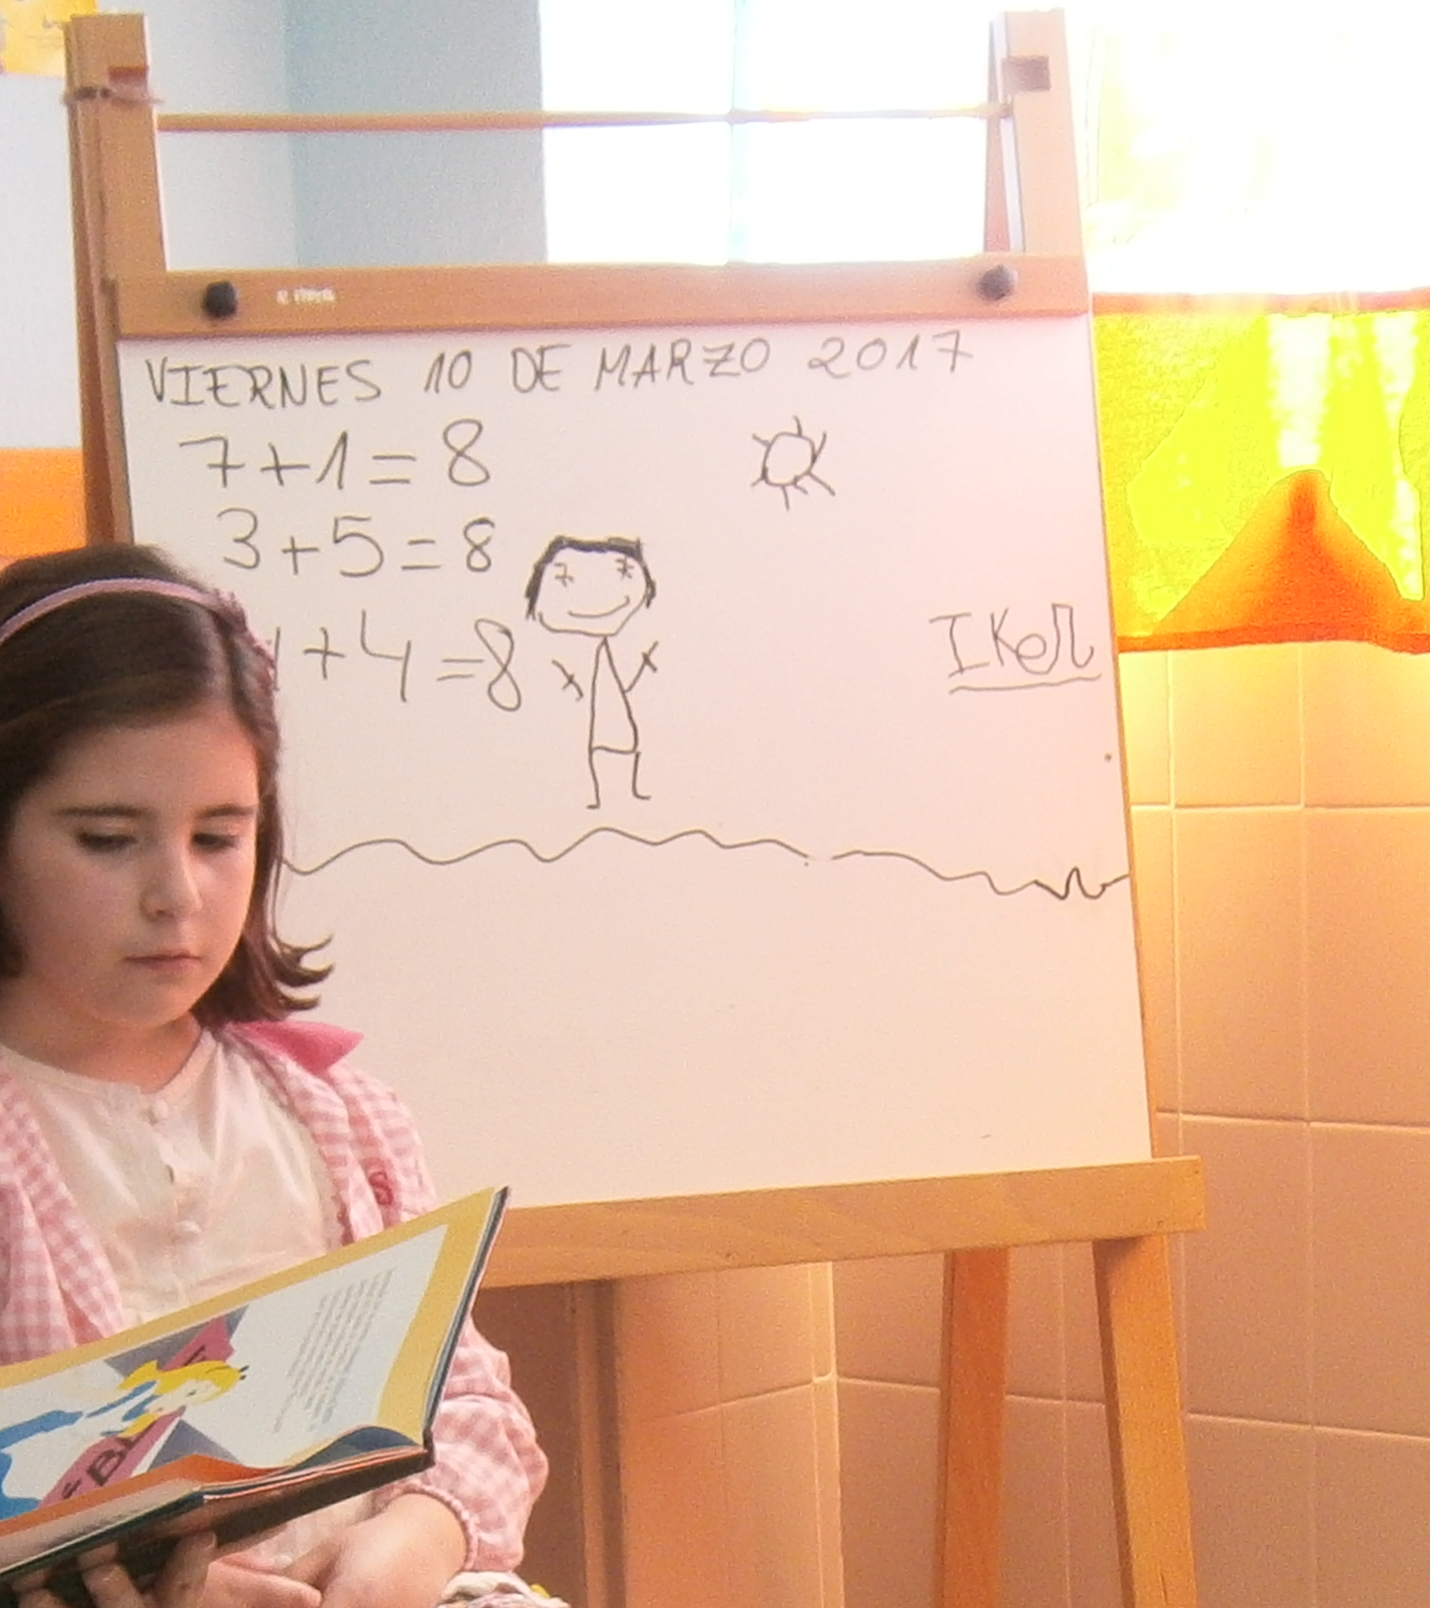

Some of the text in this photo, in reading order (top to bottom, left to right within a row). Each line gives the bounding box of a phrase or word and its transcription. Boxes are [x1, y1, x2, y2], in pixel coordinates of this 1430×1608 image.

[146, 329, 972, 409] VIERNES 10 DE MARZO 2017
